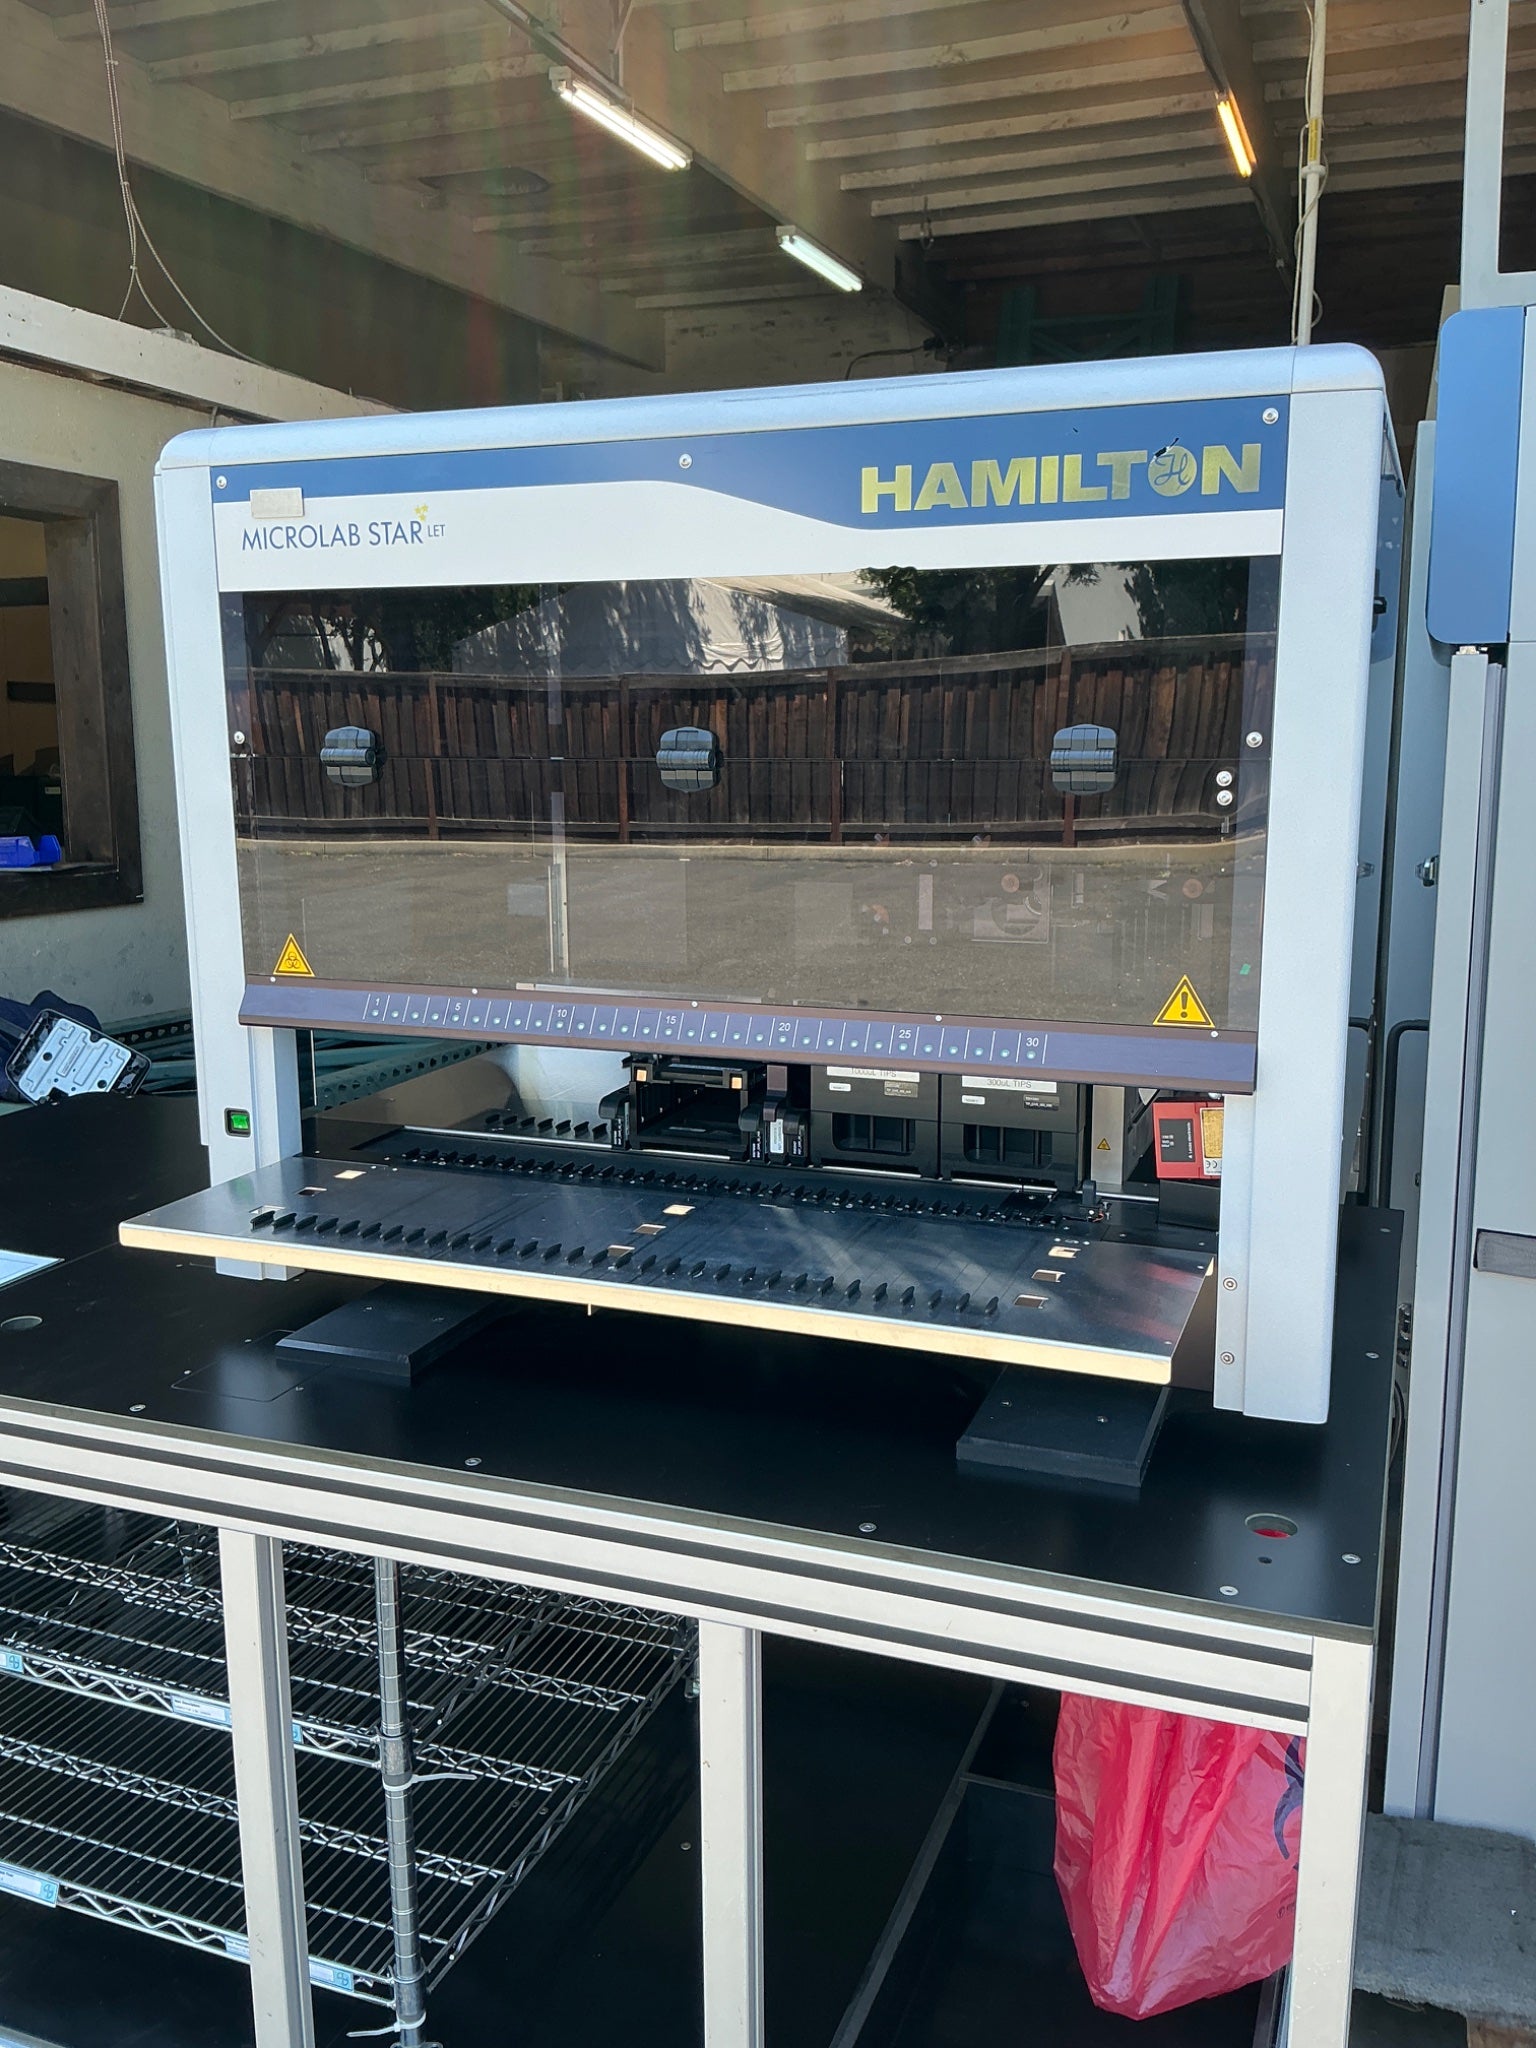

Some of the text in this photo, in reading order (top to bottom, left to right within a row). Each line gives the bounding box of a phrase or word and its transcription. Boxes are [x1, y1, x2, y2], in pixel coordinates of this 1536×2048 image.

[861, 443, 1262, 514] HAMILTON
[242, 519, 446, 551] MICROLAB STAR LET
[375, 998, 1039, 1048] 1 5 10 15 20 25 30
[1013, 1081, 1032, 1089] TIPS
